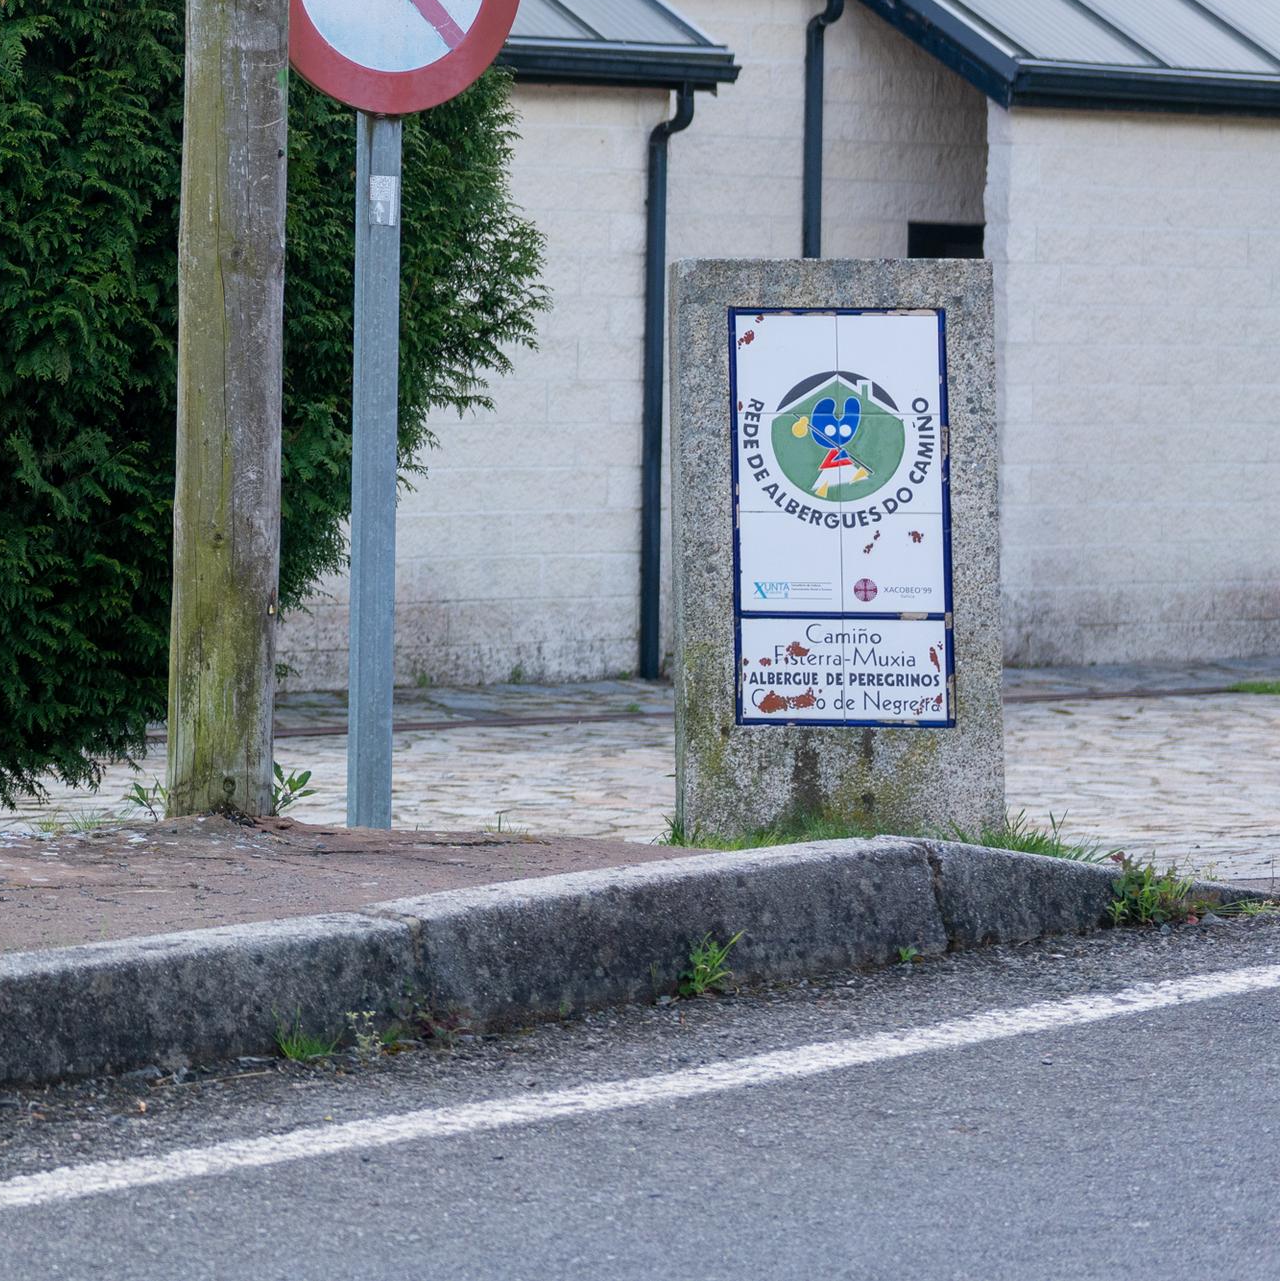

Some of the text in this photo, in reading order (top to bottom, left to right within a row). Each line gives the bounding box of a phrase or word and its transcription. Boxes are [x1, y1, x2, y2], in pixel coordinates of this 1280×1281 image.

[743, 397, 935, 529] REDE DE ALBERGUES DO CAMIÑO
[753, 582, 790, 599] XUNTA
[805, 623, 882, 644] Camiño
[749, 672, 941, 687] ALBERGUE DE PEREGRINOS
[833, 690, 856, 710] de
